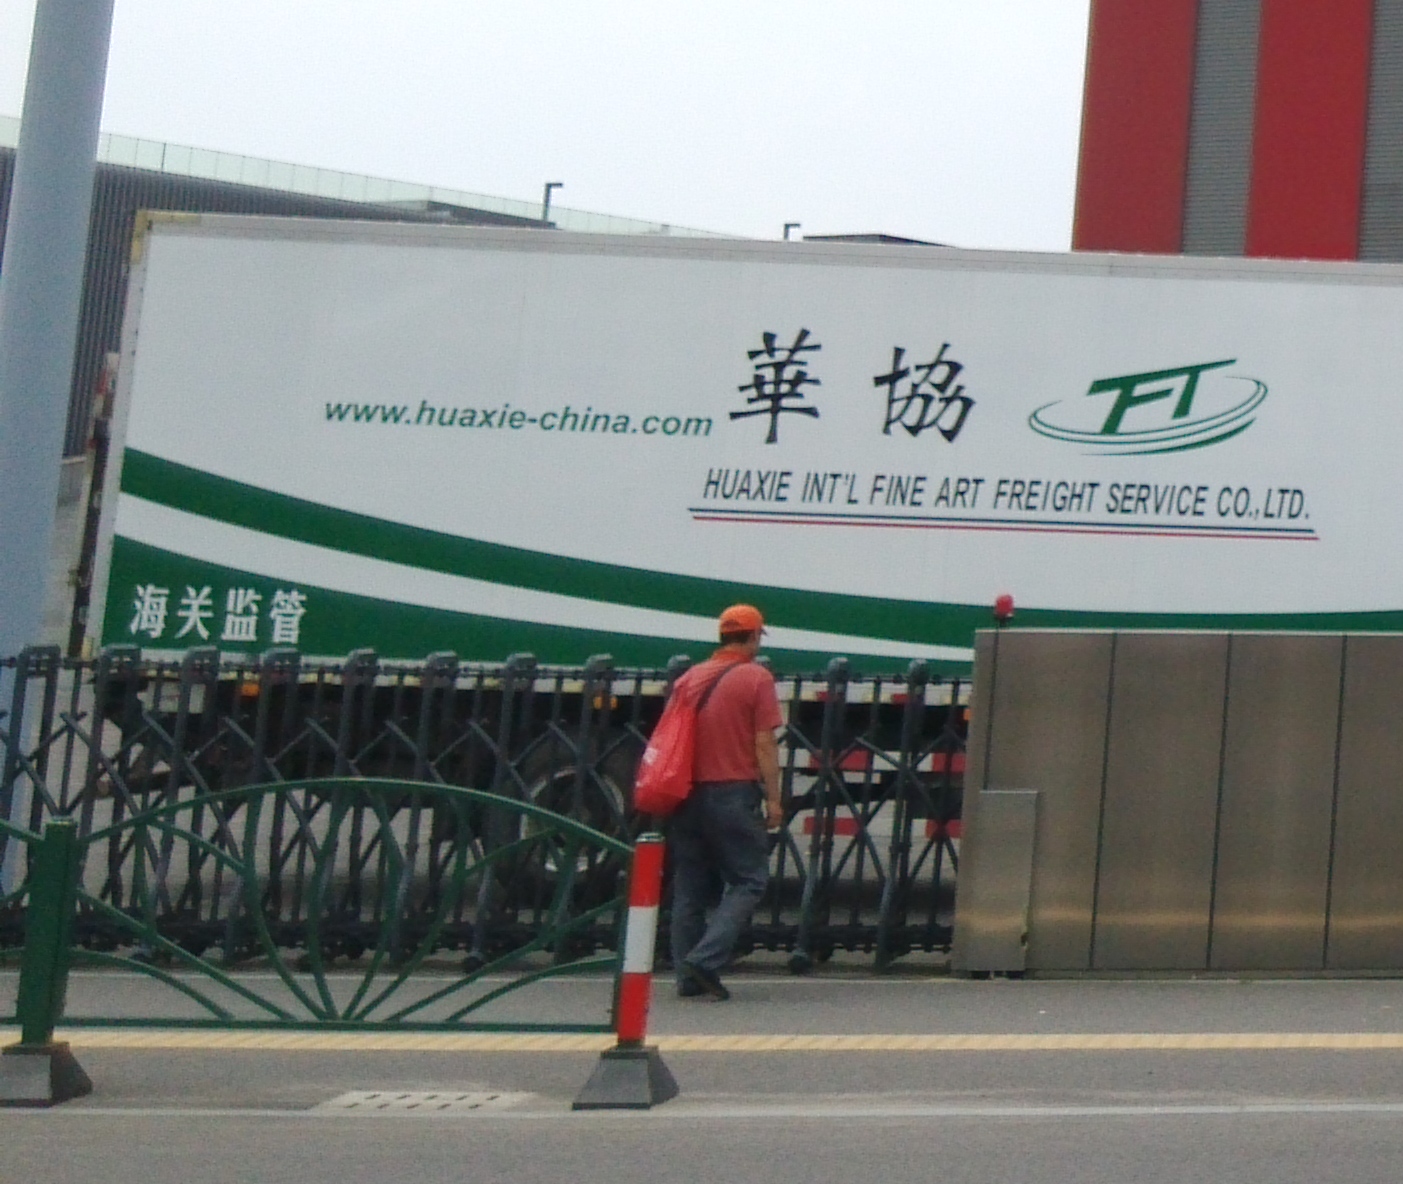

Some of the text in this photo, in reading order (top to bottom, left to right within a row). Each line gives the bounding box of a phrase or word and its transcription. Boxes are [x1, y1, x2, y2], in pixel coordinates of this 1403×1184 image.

[325, 400, 713, 437] www.huaxie-china.com
[703, 468, 792, 503] HUAXIE
[801, 471, 860, 505] INT'L
[870, 474, 927, 507] FINE
[935, 477, 985, 509] ART
[994, 478, 1100, 513] FREIGHT
[1106, 482, 1209, 516] SERVICE
[130, 583, 307, 645] 海关监管
